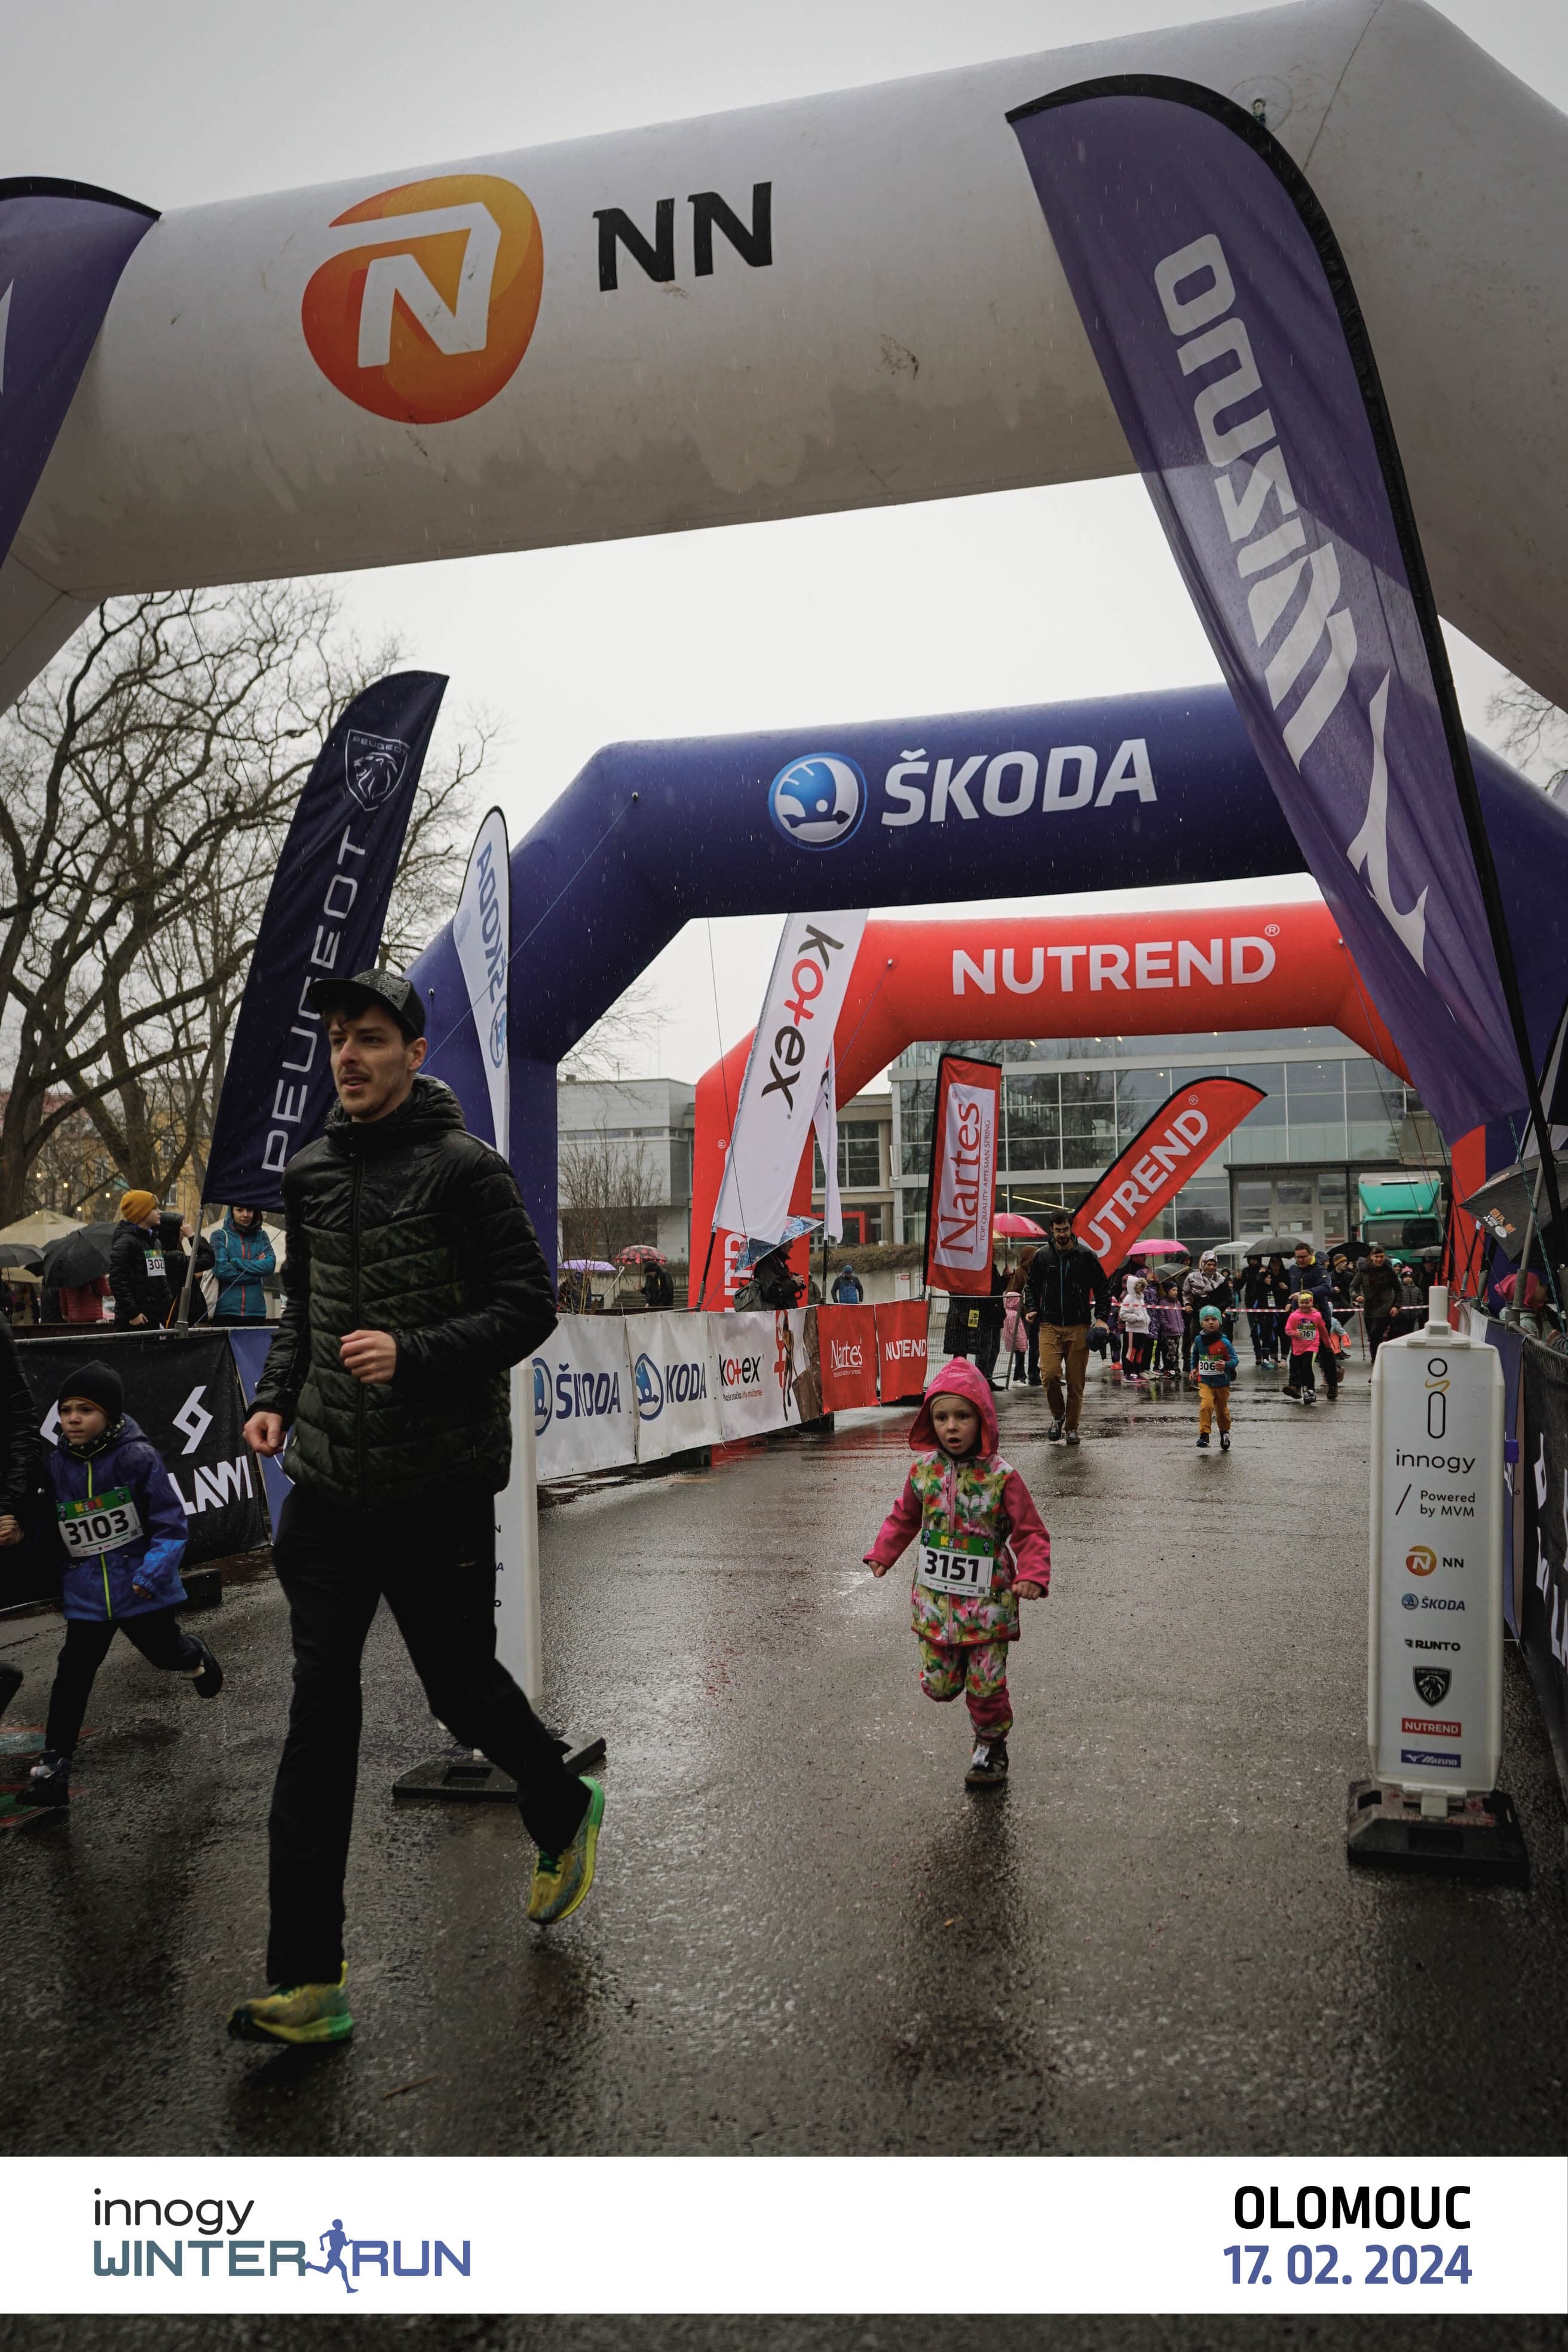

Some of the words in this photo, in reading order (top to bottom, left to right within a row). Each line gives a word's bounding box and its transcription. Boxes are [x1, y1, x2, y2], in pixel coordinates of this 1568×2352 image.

[592, 181, 773, 292] NN
[881, 748, 1157, 826] ŠKODA
[952, 936, 1276, 995] NUTREND
[940, 1102, 980, 1254] Nartes
[1078, 1109, 1208, 1258] UTREND
[831, 1340, 862, 1368] Nartes
[1200, 1362, 1215, 1370] 306
[664, 1362, 708, 1404] KODA
[1396, 1448, 1476, 1474] innogy
[1420, 1490, 1475, 1503] Powered
[1420, 1503, 1435, 1518] by
[1441, 1505, 1474, 1517] MVM
[65, 1509, 129, 1545] 3103
[924, 1550, 979, 1583] 3151
[1443, 1557, 1464, 1568] NN
[1421, 1596, 1466, 1611] ŠKODA
[1415, 1640, 1461, 1651] RUNTO
[1405, 1721, 1458, 1734] NUTREND
